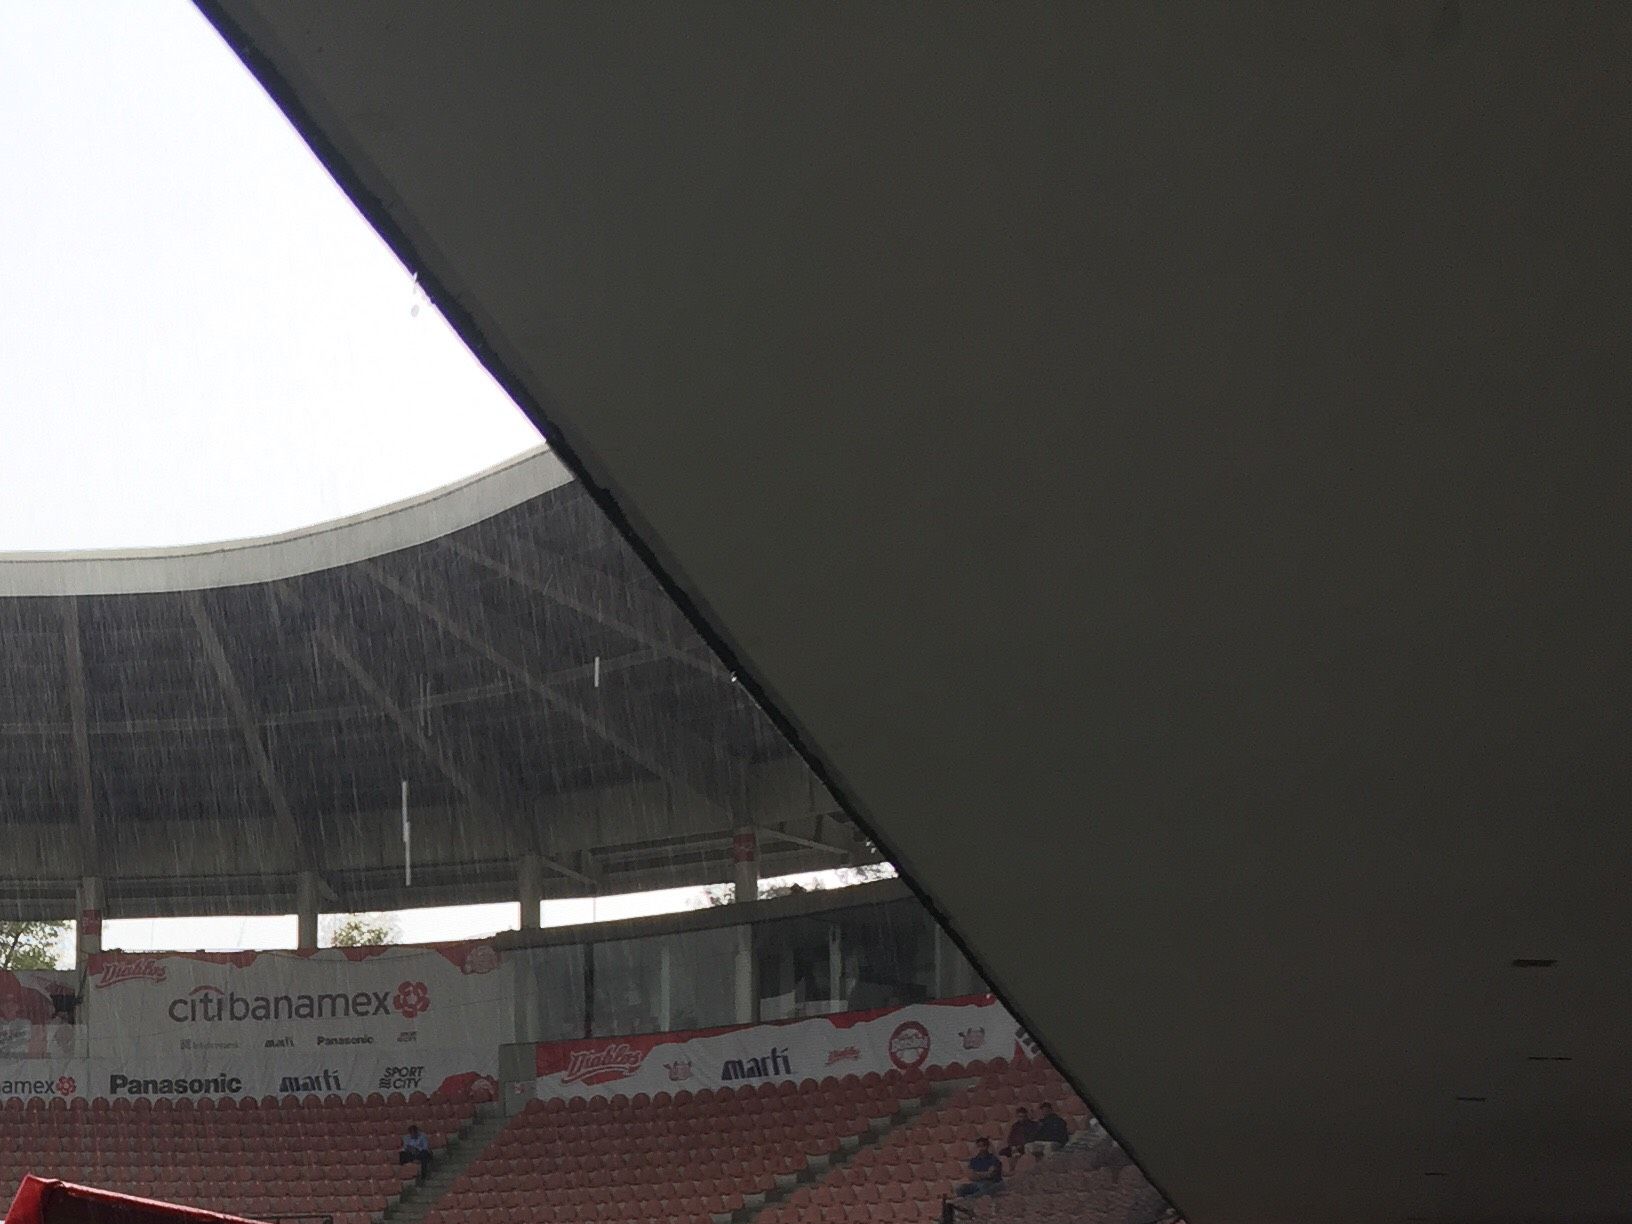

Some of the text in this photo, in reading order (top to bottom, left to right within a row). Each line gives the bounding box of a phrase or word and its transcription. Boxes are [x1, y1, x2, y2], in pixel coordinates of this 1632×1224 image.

[168, 985, 391, 1023] citibanamex
[384, 1066, 424, 1078] SPORT
[110, 1072, 242, 1095] Panasonic
[392, 1078, 422, 1090] CITY
